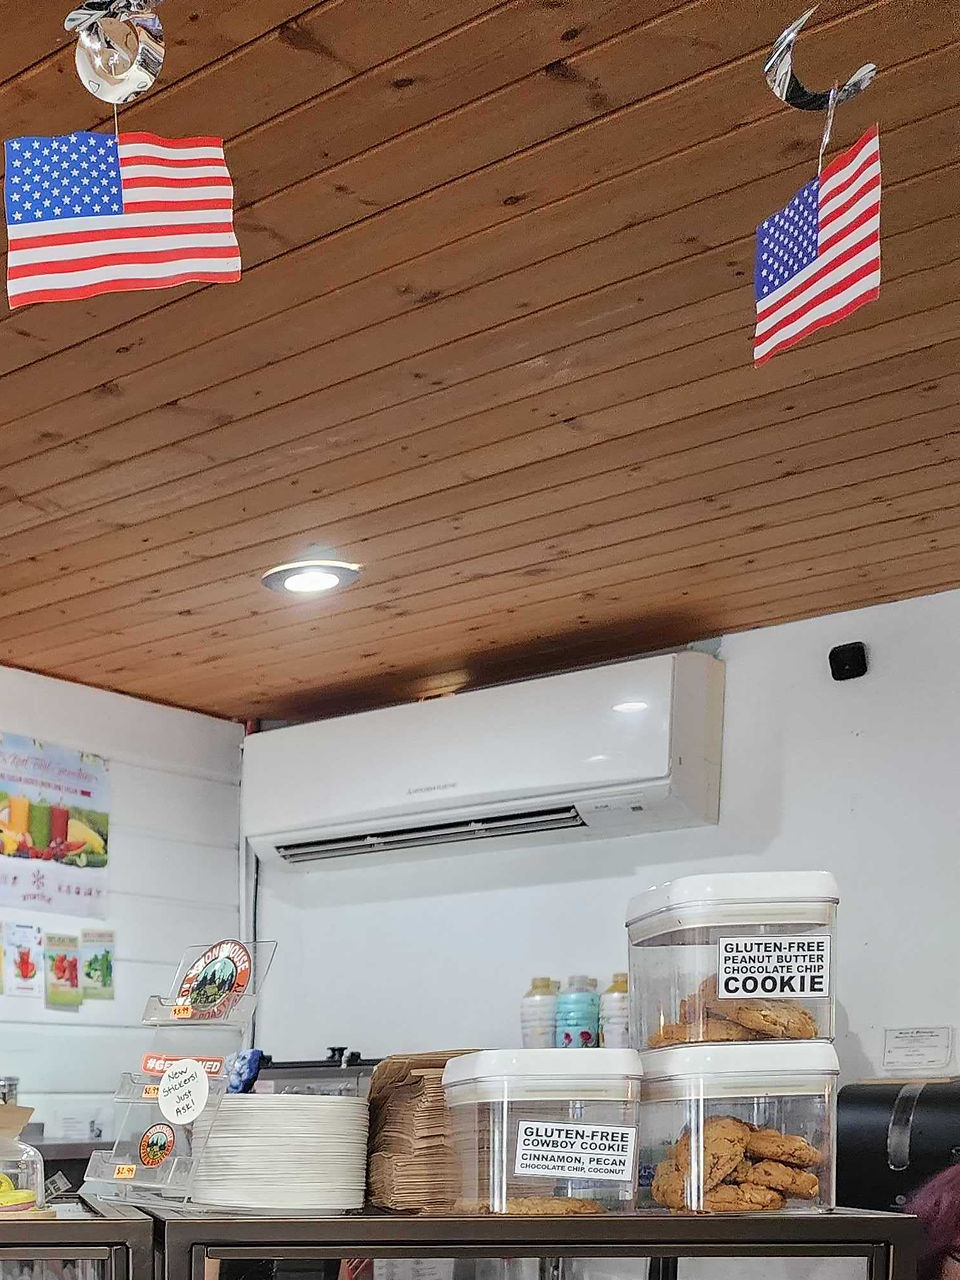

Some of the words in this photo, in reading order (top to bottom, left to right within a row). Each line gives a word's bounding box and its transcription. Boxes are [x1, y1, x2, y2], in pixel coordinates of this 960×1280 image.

[724, 942, 824, 953] GLUTEN-FREE
[724, 955, 772, 964] PEANUT
[776, 954, 824, 963] BUTTER
[724, 965, 793, 974] CHOCOLATE
[797, 964, 824, 972] CHIP
[723, 975, 825, 994] COOKIE
[167, 1066, 189, 1081] New
[175, 1089, 192, 1104] Just
[523, 1126, 630, 1143] GLUTEN-FREE
[523, 1139, 576, 1149] COWBOY
[580, 1142, 629, 1153] COOKIE
[521, 1154, 585, 1164] CINNAMON,
[588, 1156, 627, 1167] PECAN
[520, 1163, 566, 1171] CHOCOLATE
[568, 1165, 586, 1174] CHIP,
[587, 1166, 625, 1175] COCONUT
